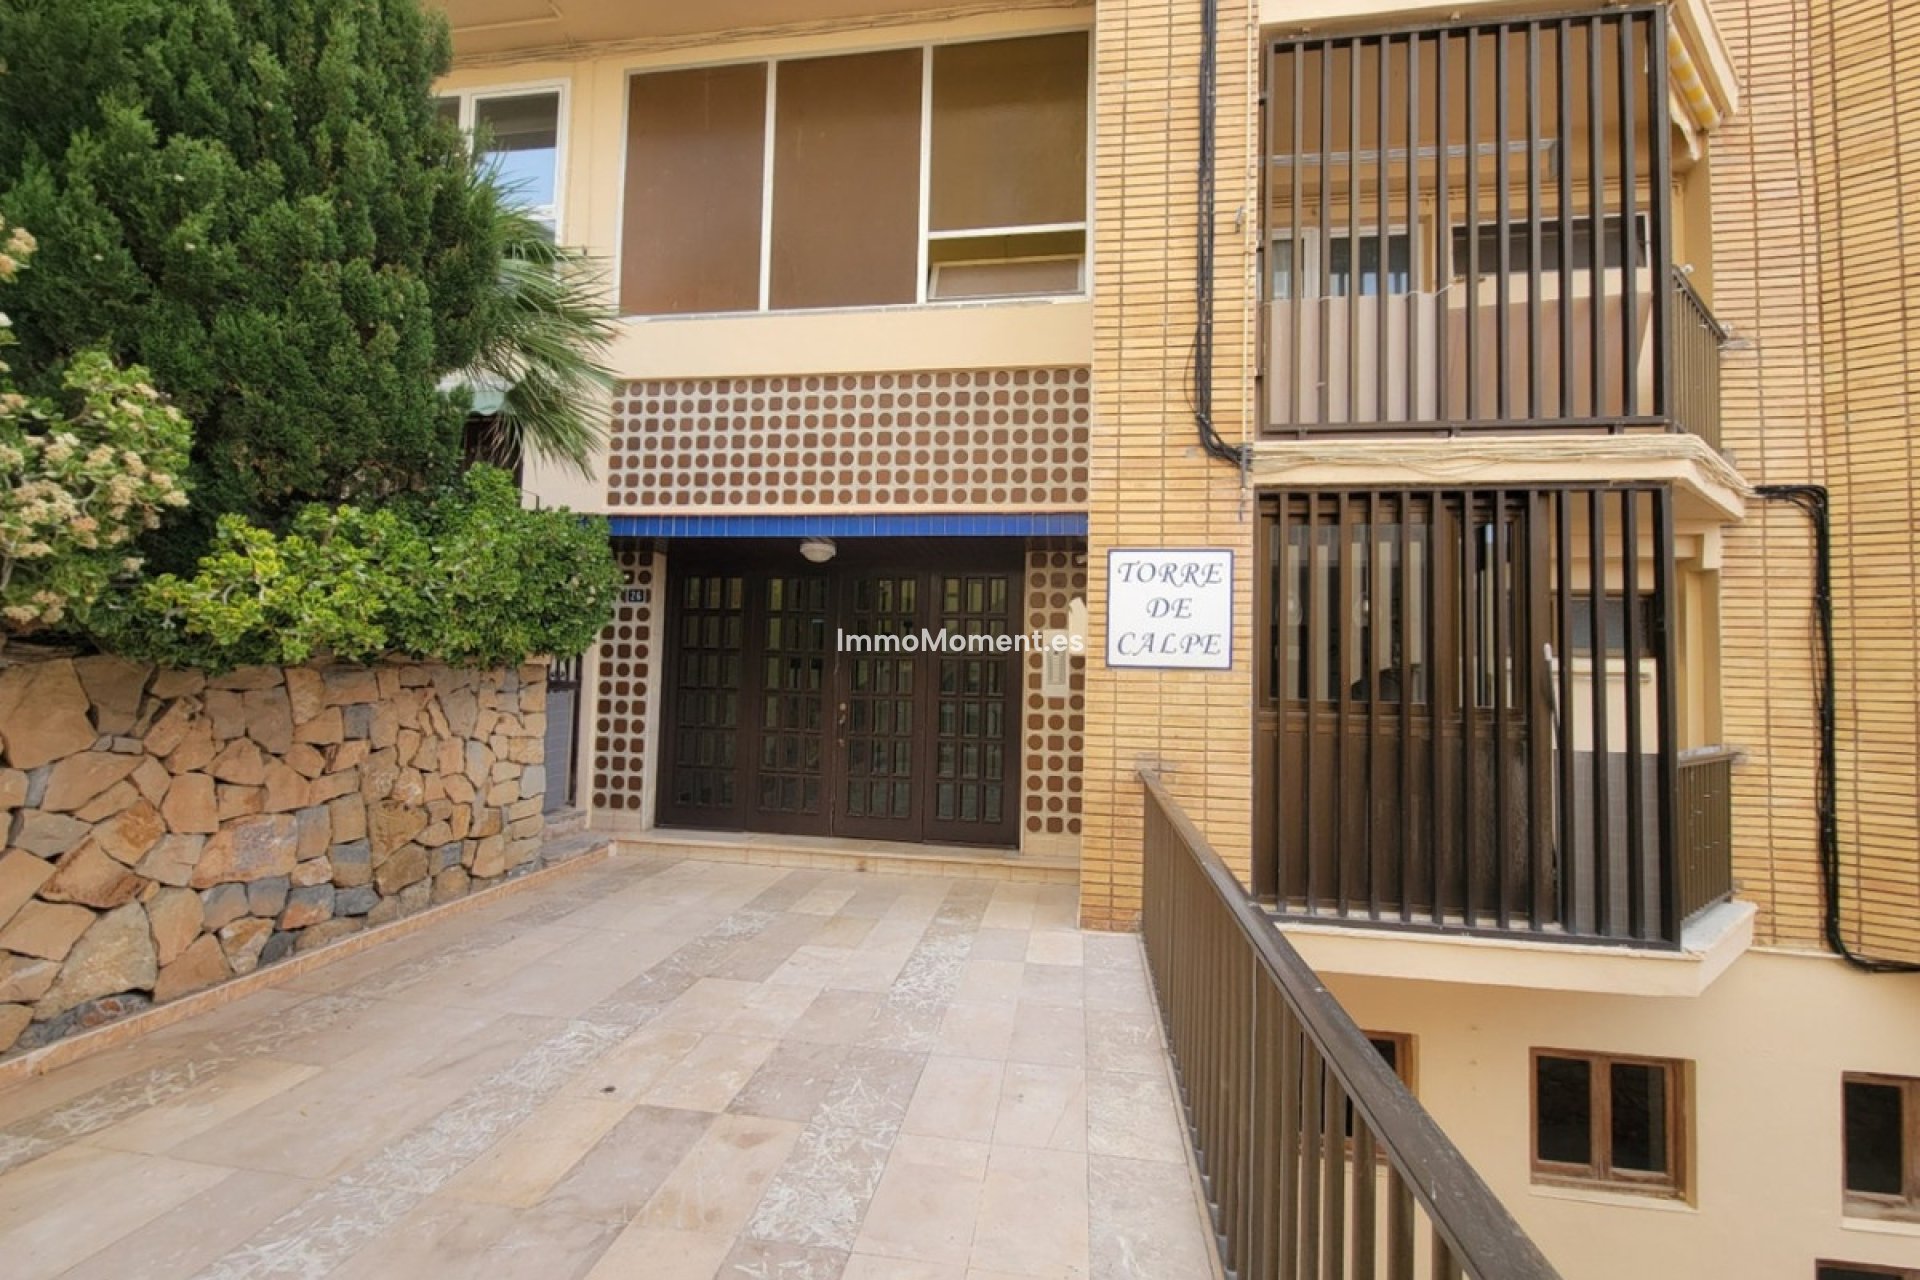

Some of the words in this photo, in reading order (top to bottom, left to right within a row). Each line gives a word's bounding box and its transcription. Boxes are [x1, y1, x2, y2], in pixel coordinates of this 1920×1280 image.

[1117, 560, 1223, 588] TORRE
[1146, 597, 1192, 619] DE
[1117, 632, 1222, 656] CALPE
